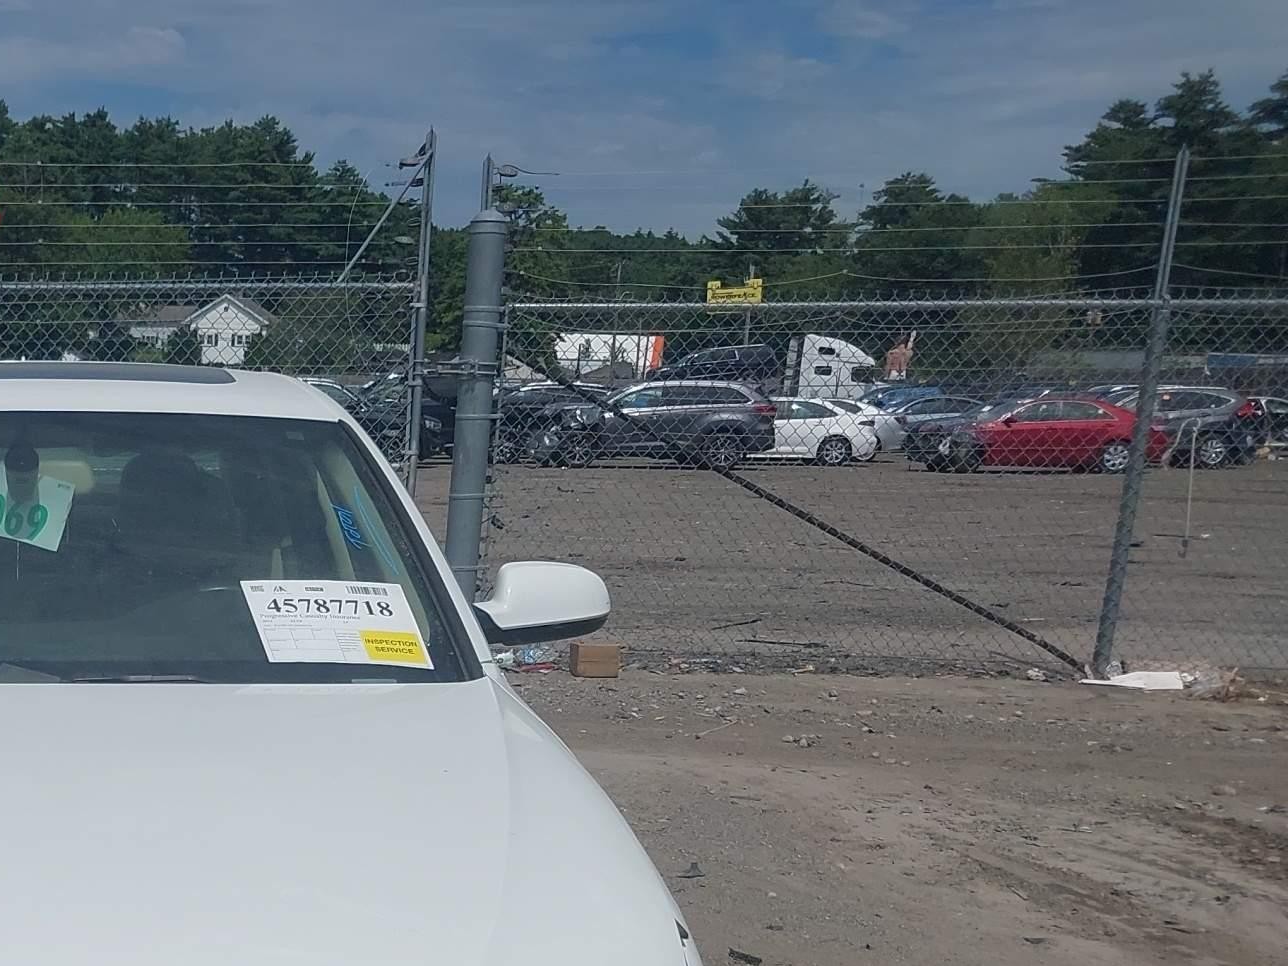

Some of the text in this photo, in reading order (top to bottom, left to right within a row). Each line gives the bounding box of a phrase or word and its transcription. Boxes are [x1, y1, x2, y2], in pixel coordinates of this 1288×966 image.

[267, 598, 394, 617] 45787718
[364, 638, 418, 648] INSPECTION
[375, 646, 415, 654] SERVICE
